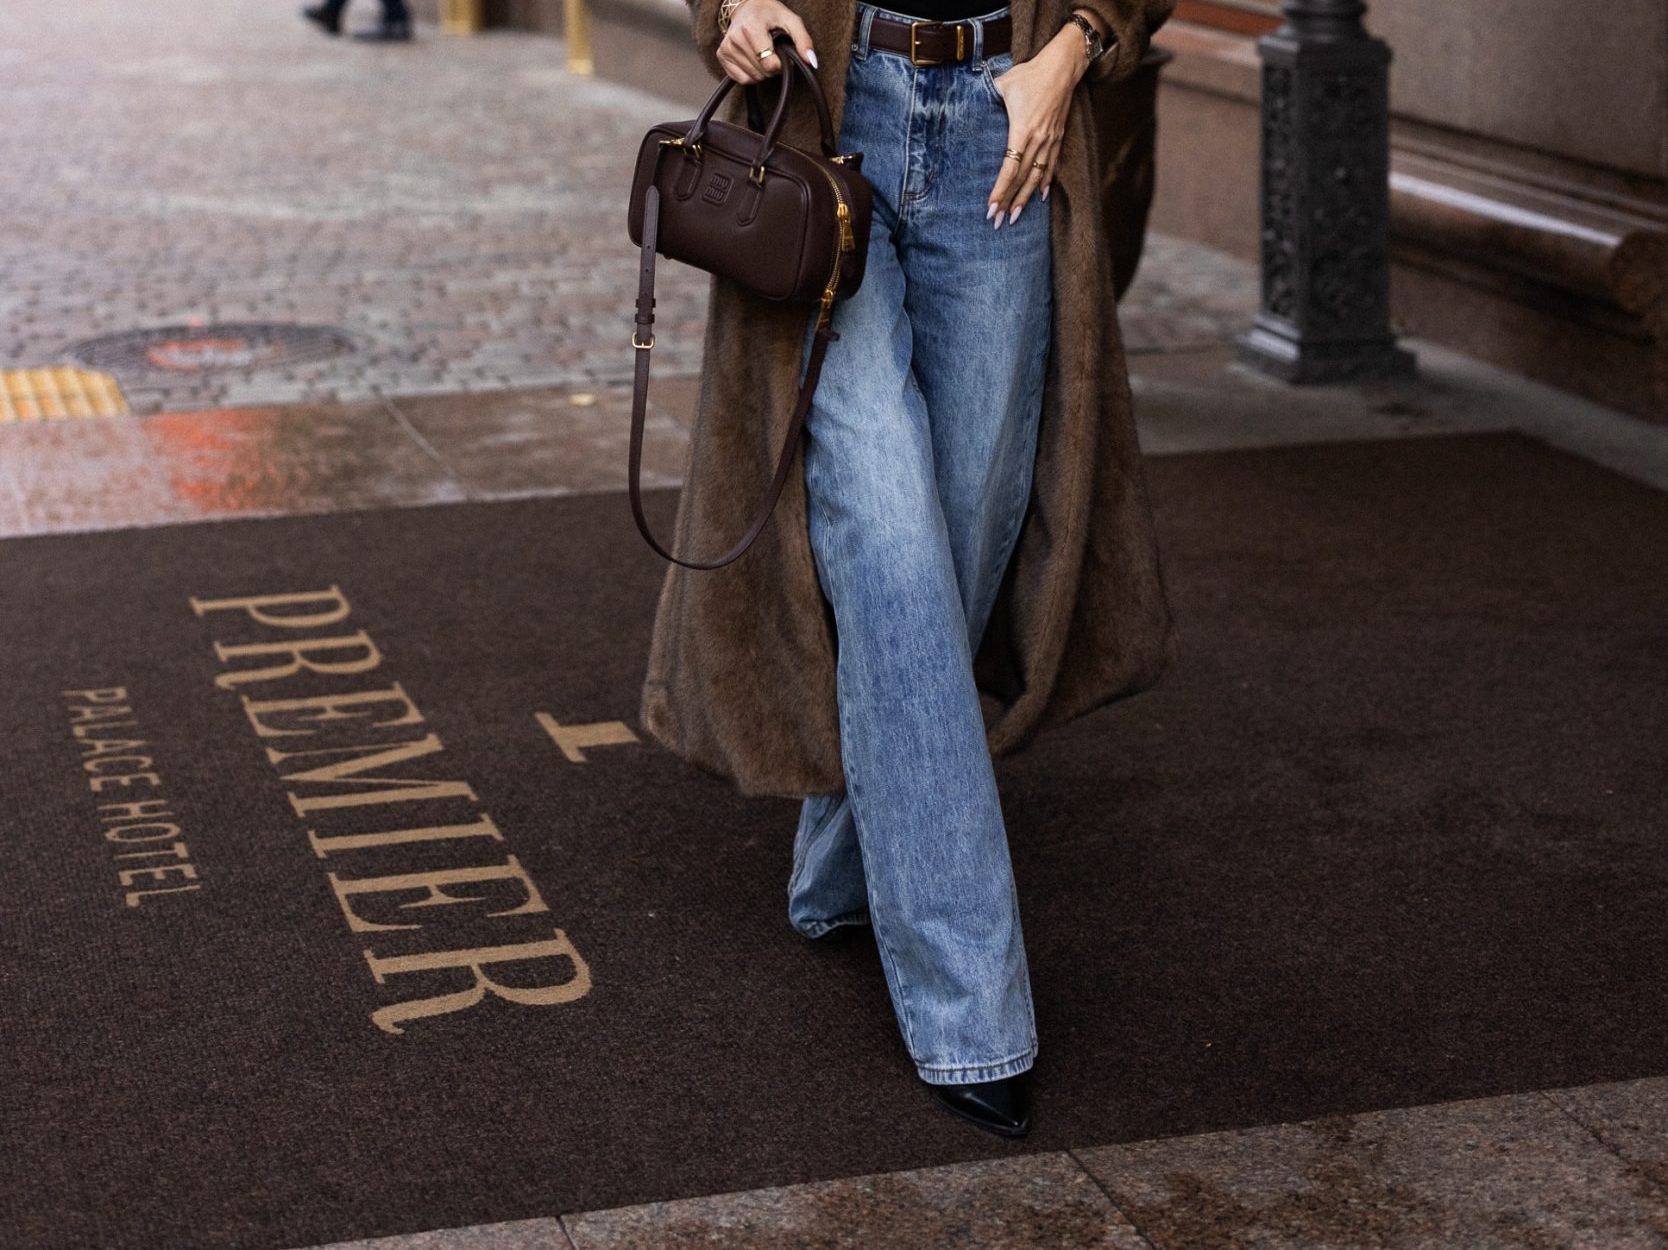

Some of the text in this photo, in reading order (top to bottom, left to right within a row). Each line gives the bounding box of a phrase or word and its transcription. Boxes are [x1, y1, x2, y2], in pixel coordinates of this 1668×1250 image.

[62, 686, 201, 908] PALACE HOTEL
[189, 584, 593, 1034] PREMIER
